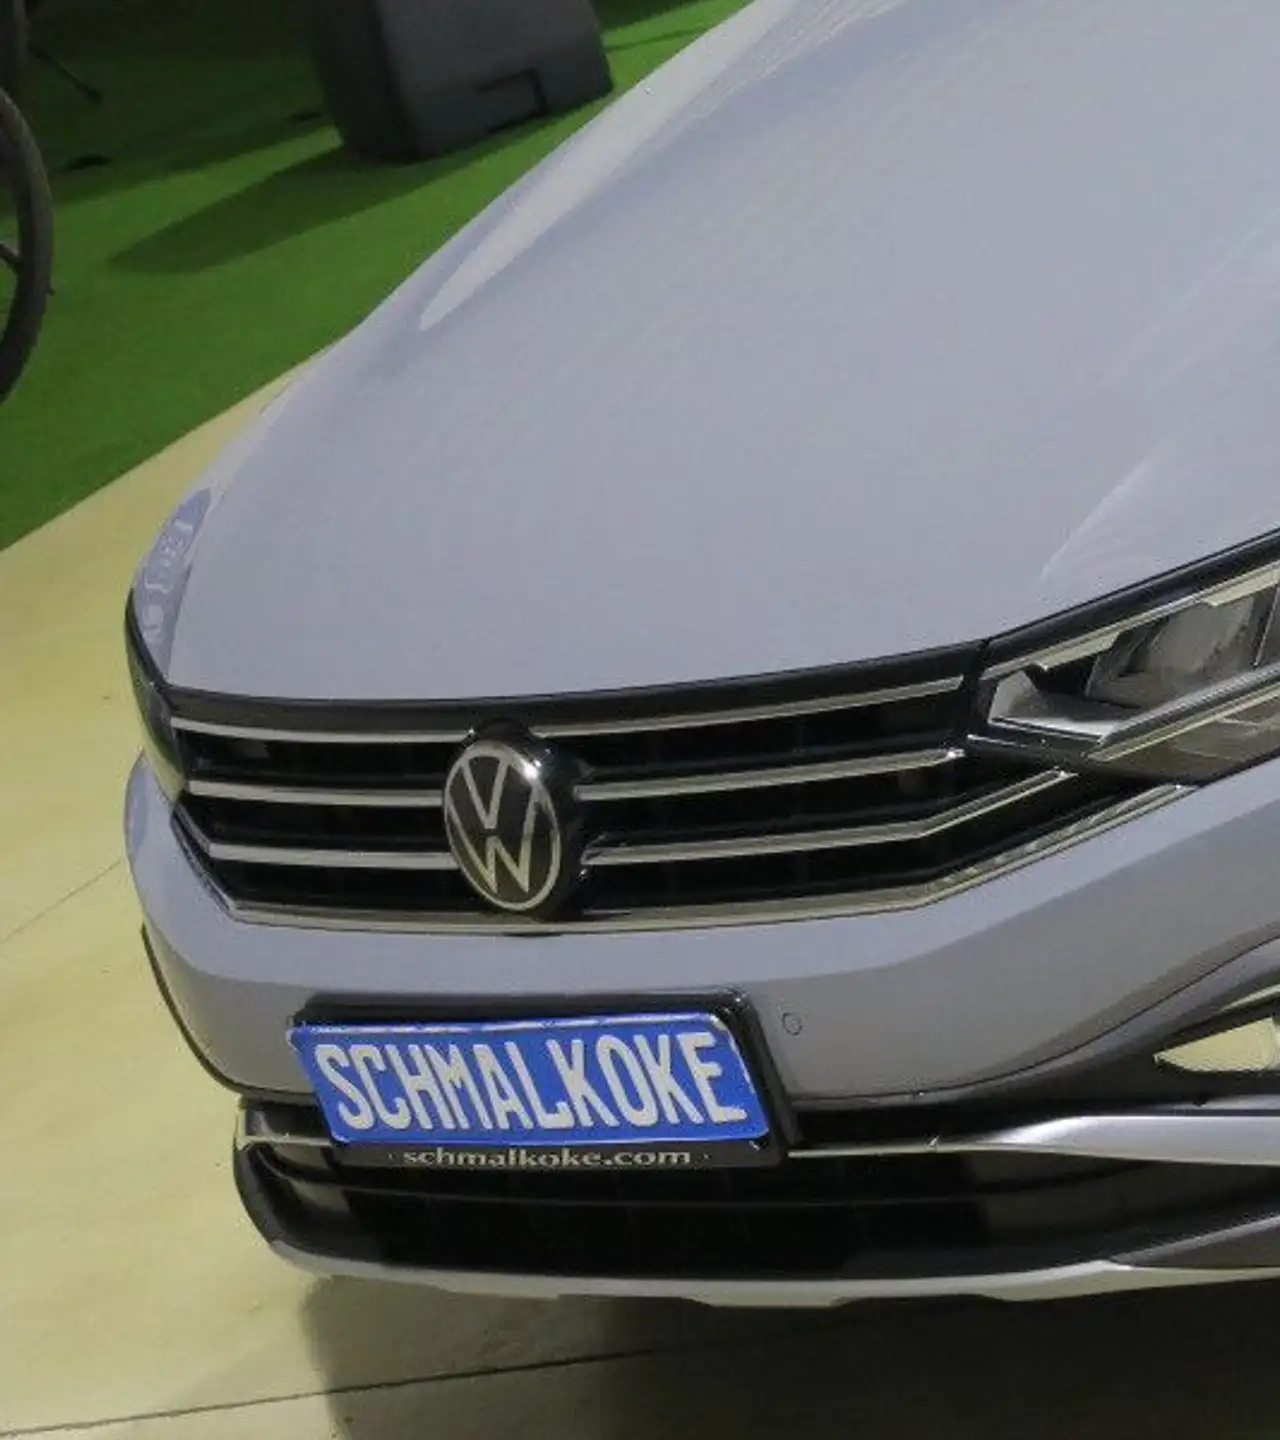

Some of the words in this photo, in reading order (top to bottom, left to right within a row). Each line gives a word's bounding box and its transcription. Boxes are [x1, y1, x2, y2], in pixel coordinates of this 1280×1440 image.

[446, 743, 557, 904] VW
[313, 1031, 748, 1131] SCHMALKOKE
[403, 1146, 692, 1169] schmalkoke.com
